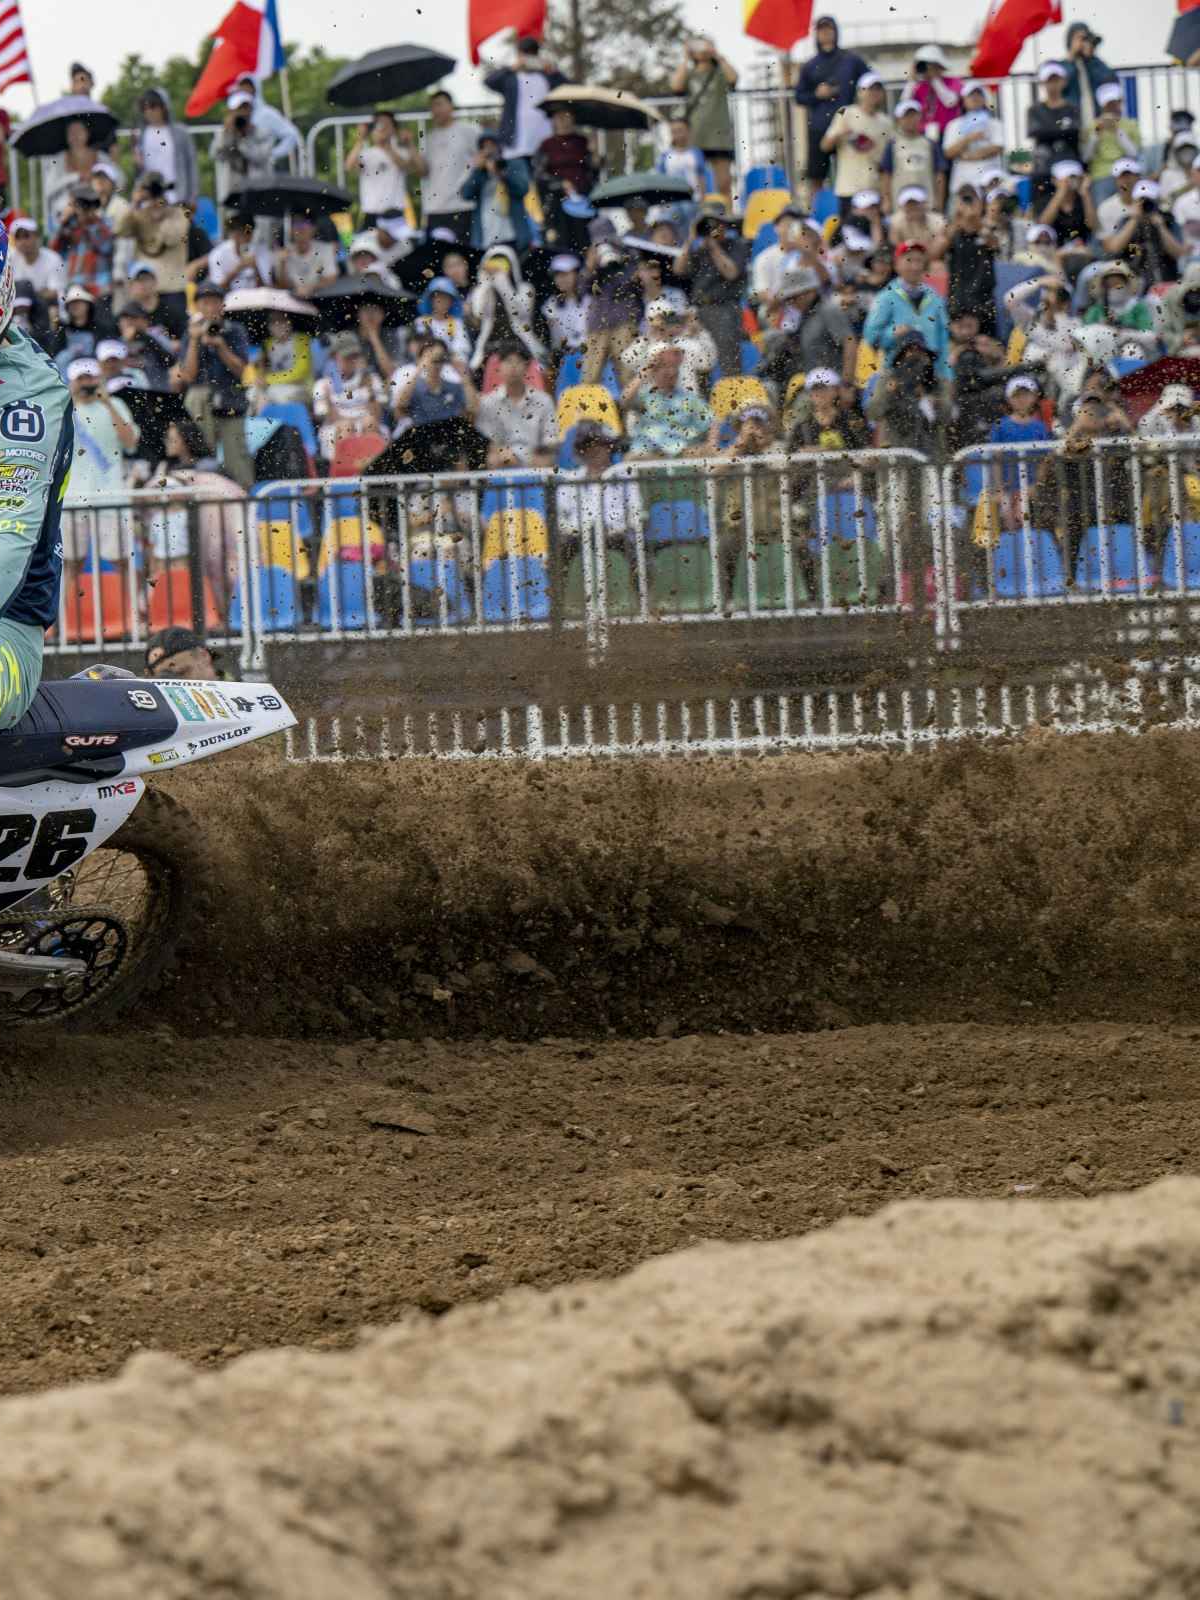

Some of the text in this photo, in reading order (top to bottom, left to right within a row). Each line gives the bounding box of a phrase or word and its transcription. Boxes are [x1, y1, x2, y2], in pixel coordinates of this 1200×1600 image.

[5, 448, 48, 463] MOTOREX
[64, 734, 119, 747] GUTS
[199, 725, 251, 748] DUNLOP
